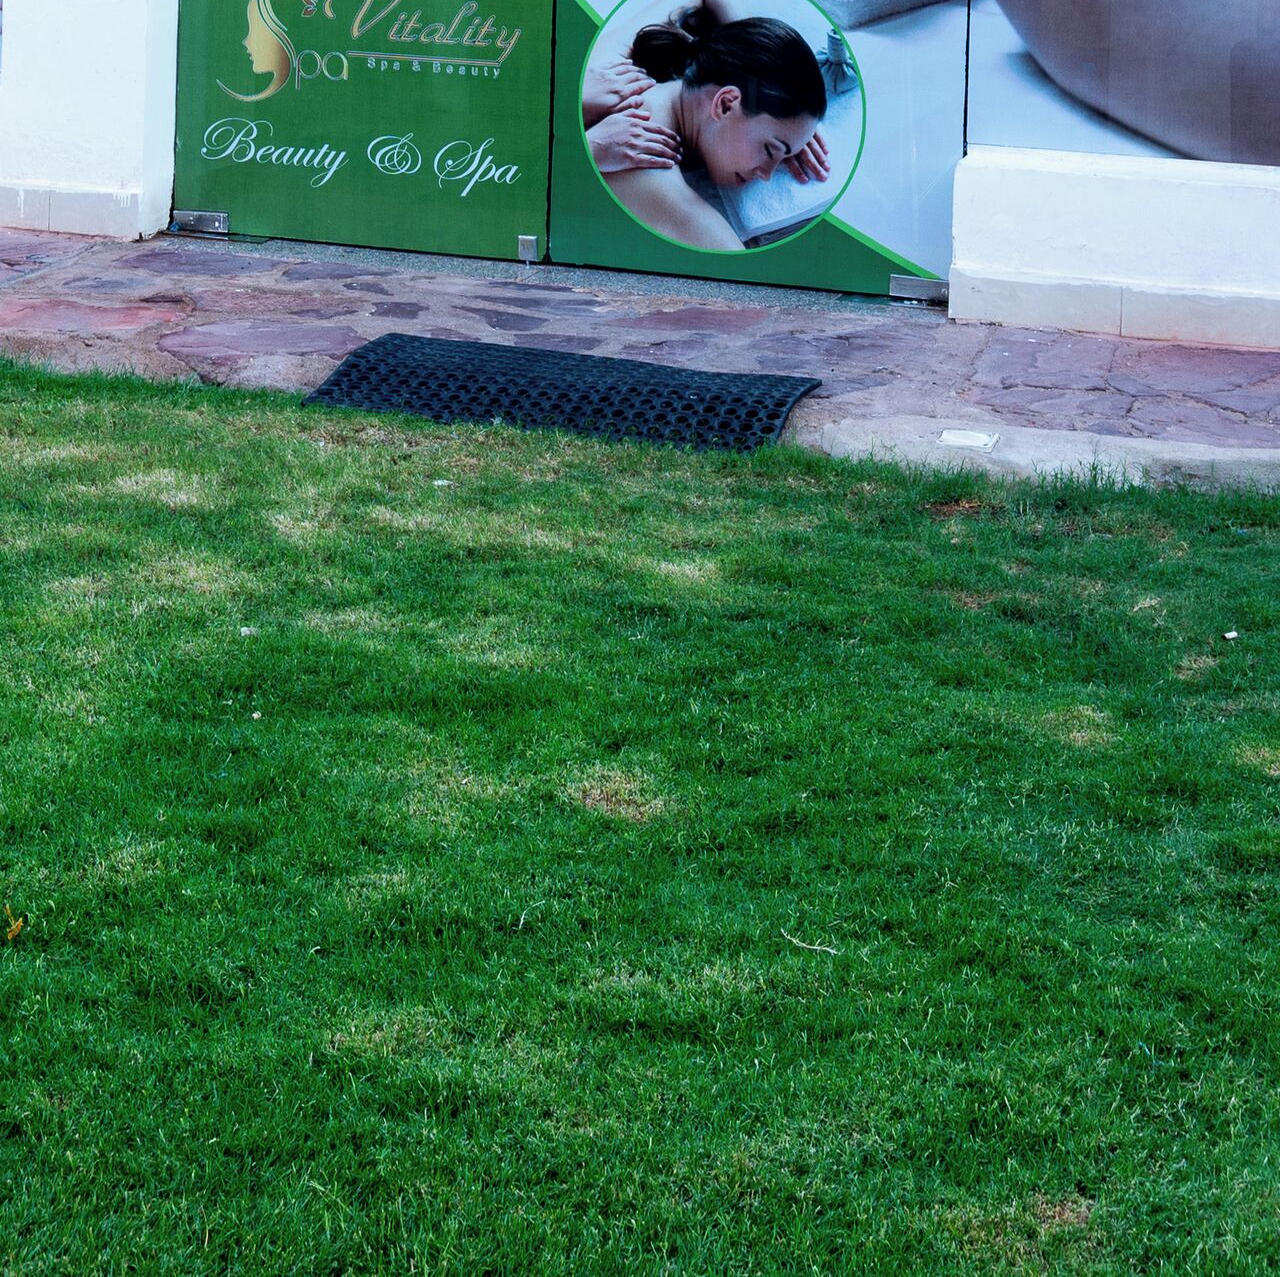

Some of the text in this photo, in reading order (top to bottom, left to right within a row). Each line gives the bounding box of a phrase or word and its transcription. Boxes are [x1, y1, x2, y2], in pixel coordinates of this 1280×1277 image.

[367, 56, 501, 80] Spa & Beauty
[200, 117, 522, 197] Beauty & Spa
